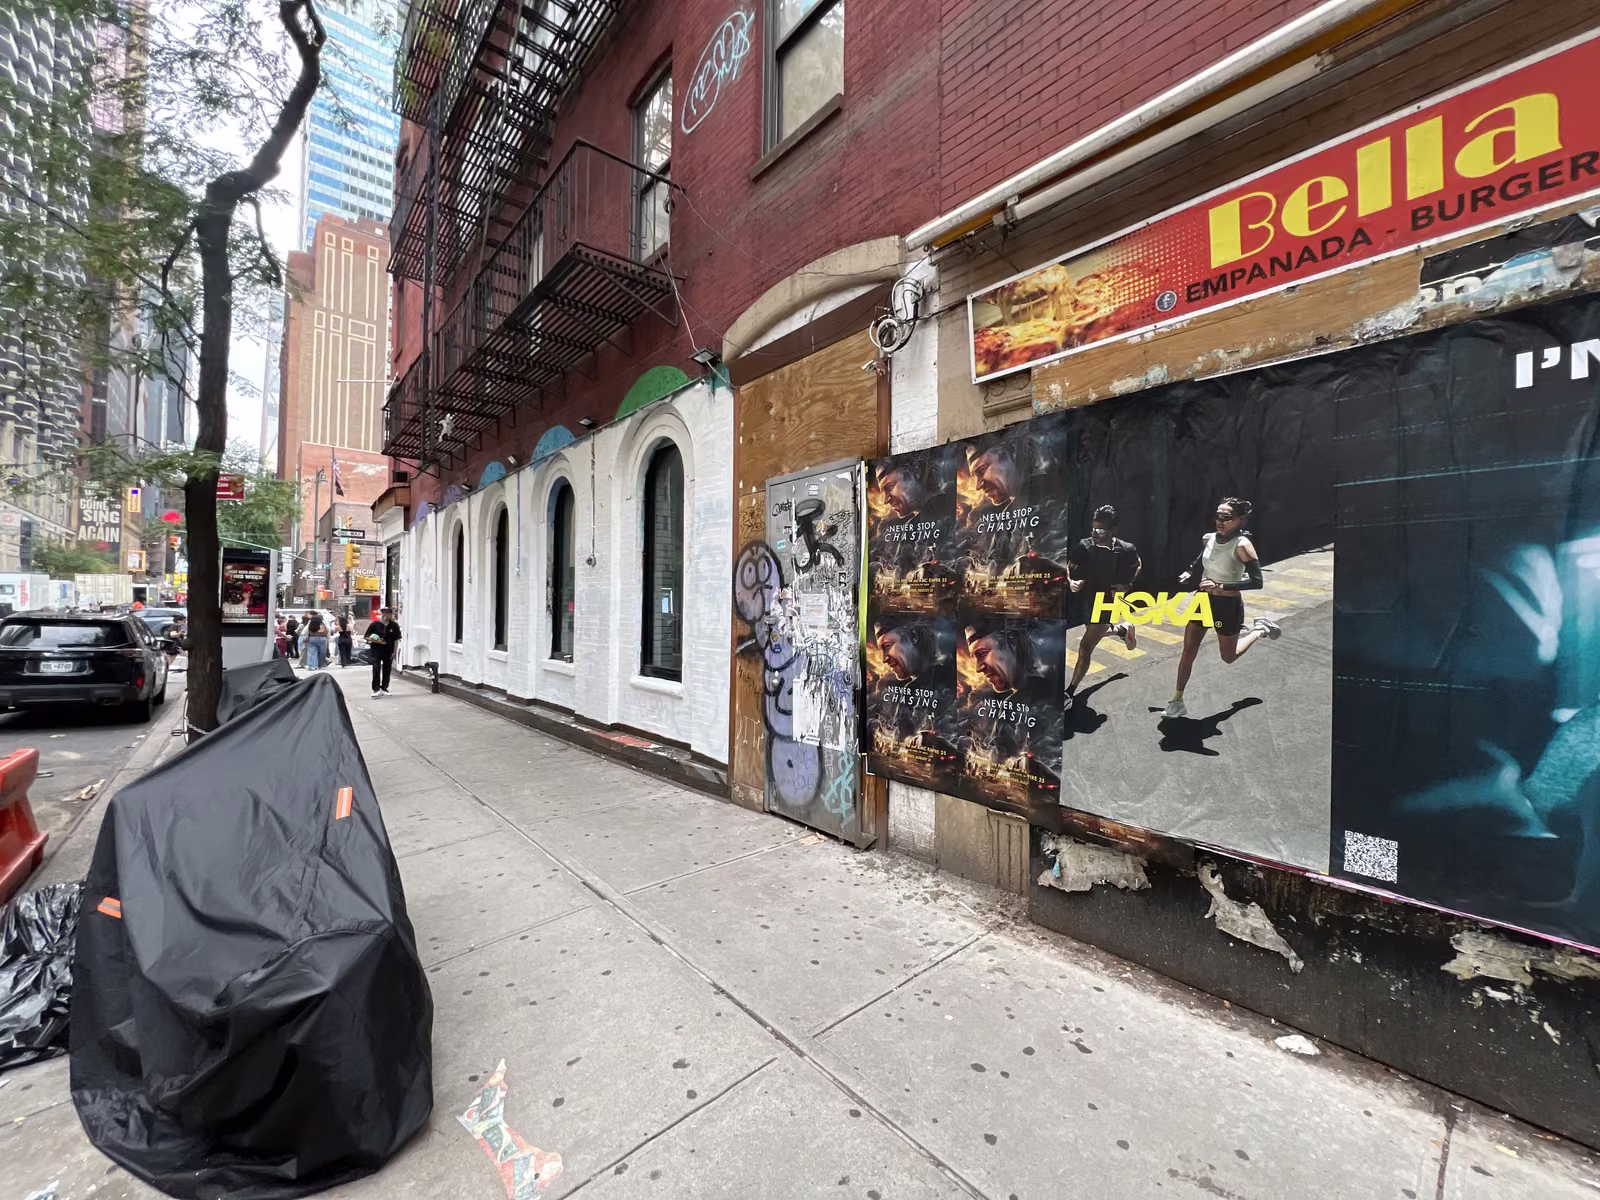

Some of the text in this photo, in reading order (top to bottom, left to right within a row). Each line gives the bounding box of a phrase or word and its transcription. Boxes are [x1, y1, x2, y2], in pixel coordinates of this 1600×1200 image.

[1209, 93, 1563, 269] Bella
[1186, 227, 1373, 303] EMPANADA
[82, 509, 120, 523] SING
[982, 507, 1032, 522] NEVER STOP
[889, 521, 936, 533] NEVER STOP
[977, 516, 1040, 534] CHASING
[78, 525, 120, 542] AGAIN
[884, 529, 940, 542] CHASING
[1090, 591, 1215, 628] HOKA
[888, 686, 934, 698] NEVER STOP
[883, 693, 938, 709] CHASING
[984, 699, 1012, 711] NEVER
